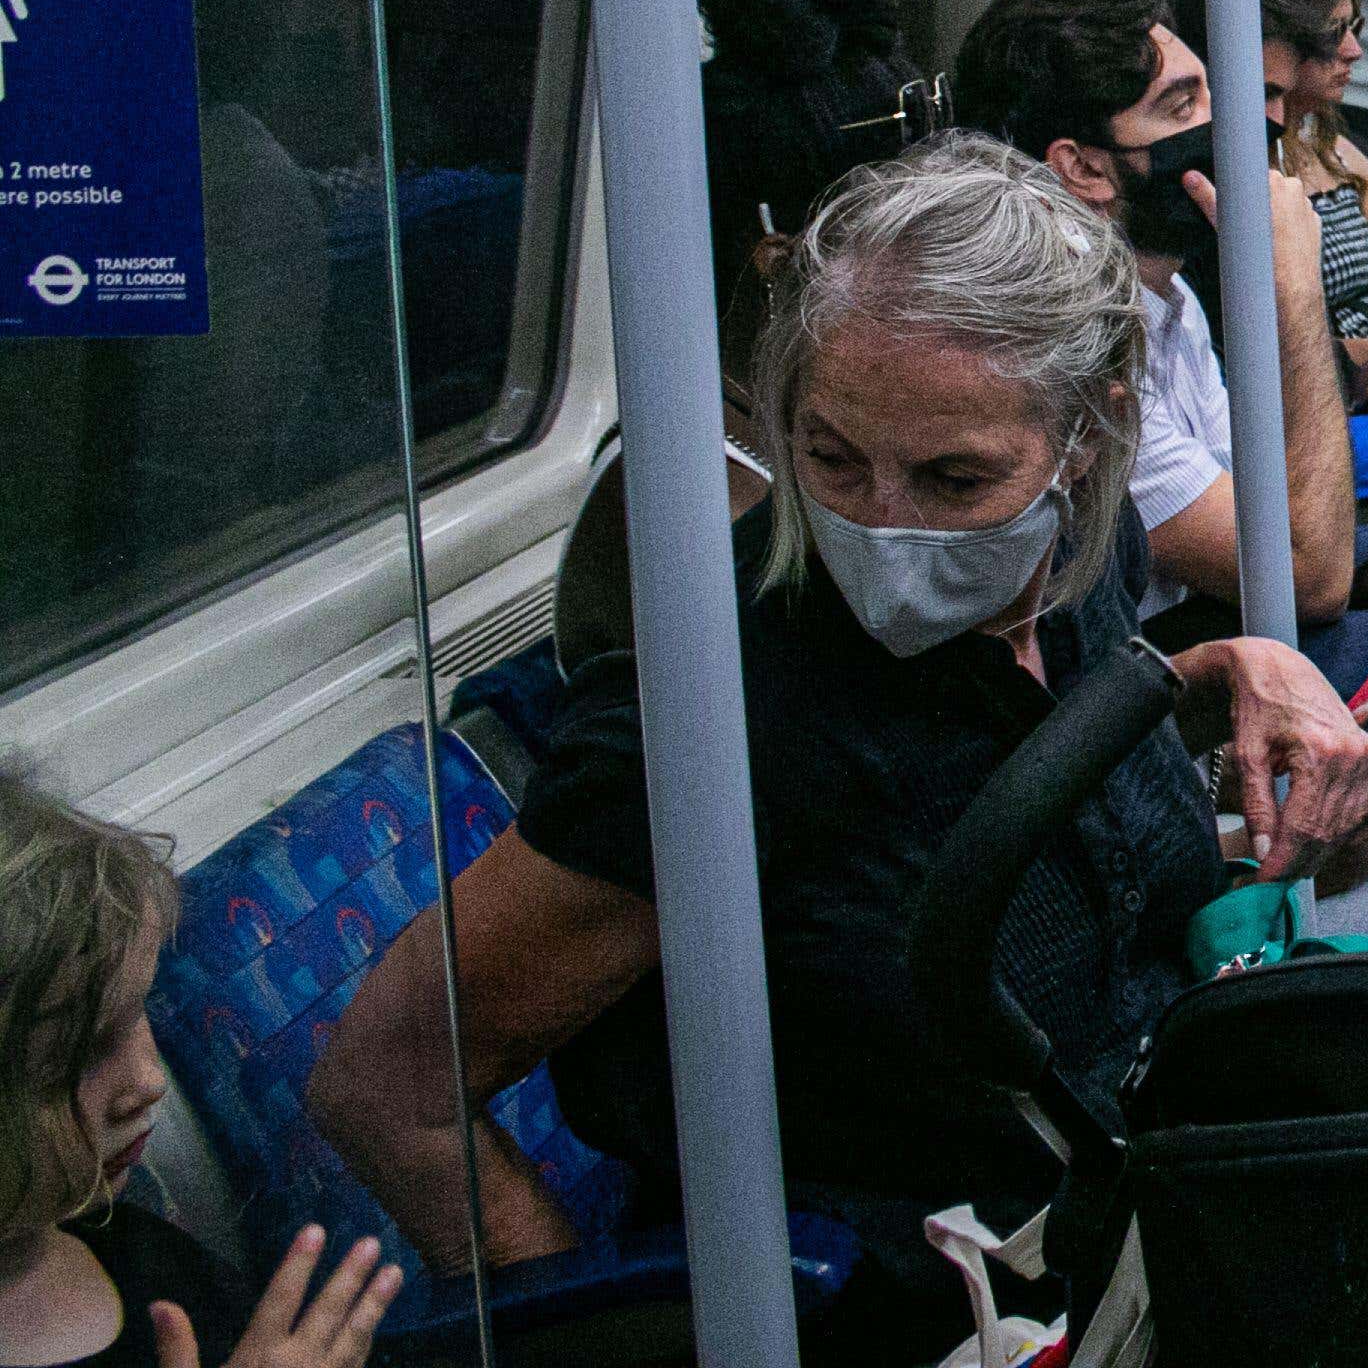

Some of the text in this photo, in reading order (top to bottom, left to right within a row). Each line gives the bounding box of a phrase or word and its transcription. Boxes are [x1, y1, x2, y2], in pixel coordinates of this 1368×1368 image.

[10, 161, 92, 180] 2 metre
[35, 185, 123, 209] possible
[96, 258, 176, 271] TRANSPORT
[96, 273, 185, 287] FOR LONDON
